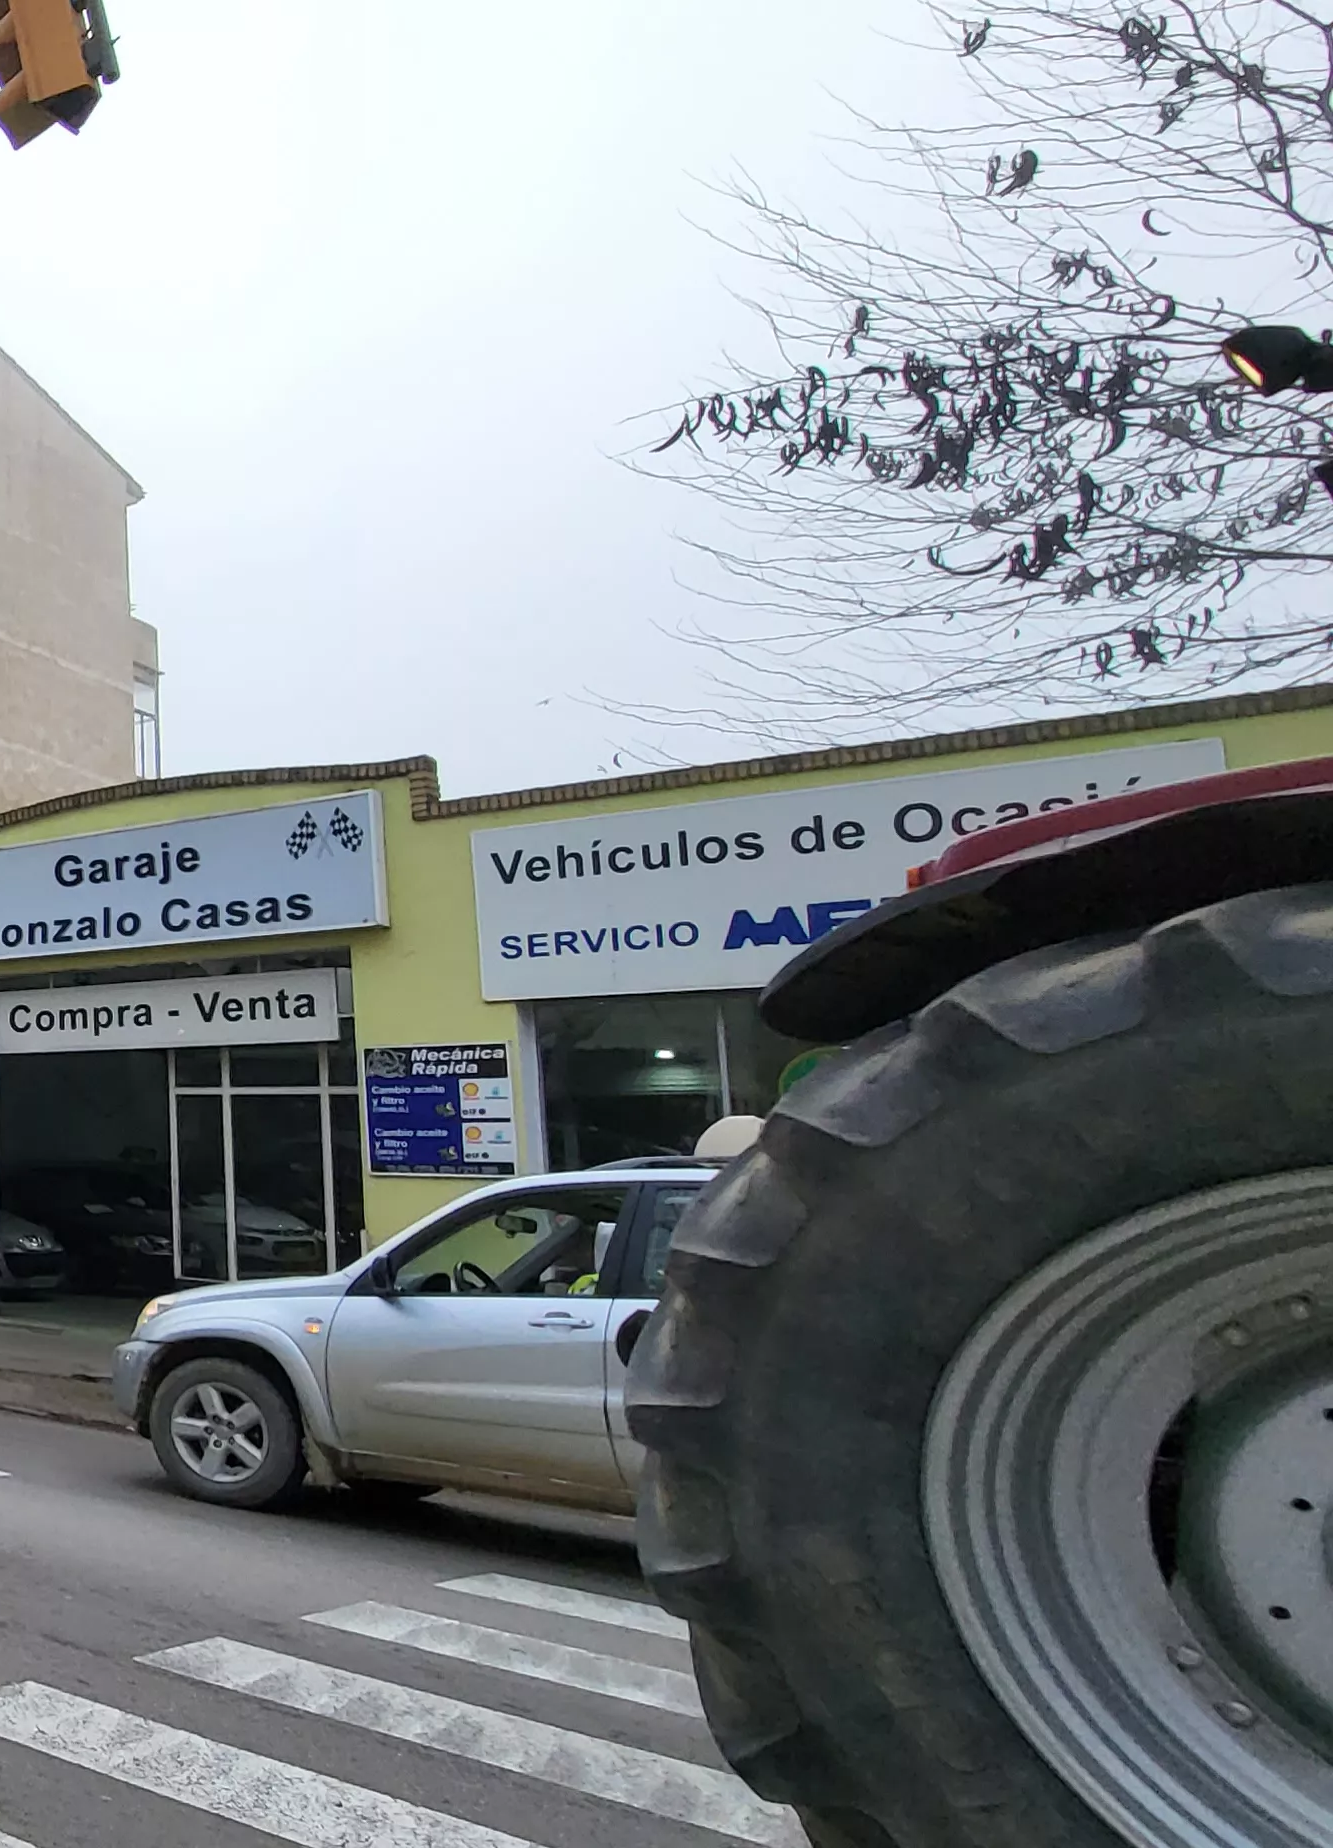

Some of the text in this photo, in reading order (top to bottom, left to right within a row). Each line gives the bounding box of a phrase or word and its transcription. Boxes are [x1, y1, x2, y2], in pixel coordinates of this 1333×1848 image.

[54, 842, 201, 888] Garaje
[490, 830, 765, 885] Vehículos
[791, 815, 866, 855] de
[161, 893, 314, 933] Casas
[499, 921, 700, 960] SERVICIO
[9, 1003, 153, 1037] Compra
[192, 989, 317, 1024] Venta
[411, 1047, 505, 1062] Mecánica
[411, 1061, 478, 1078] Rápida
